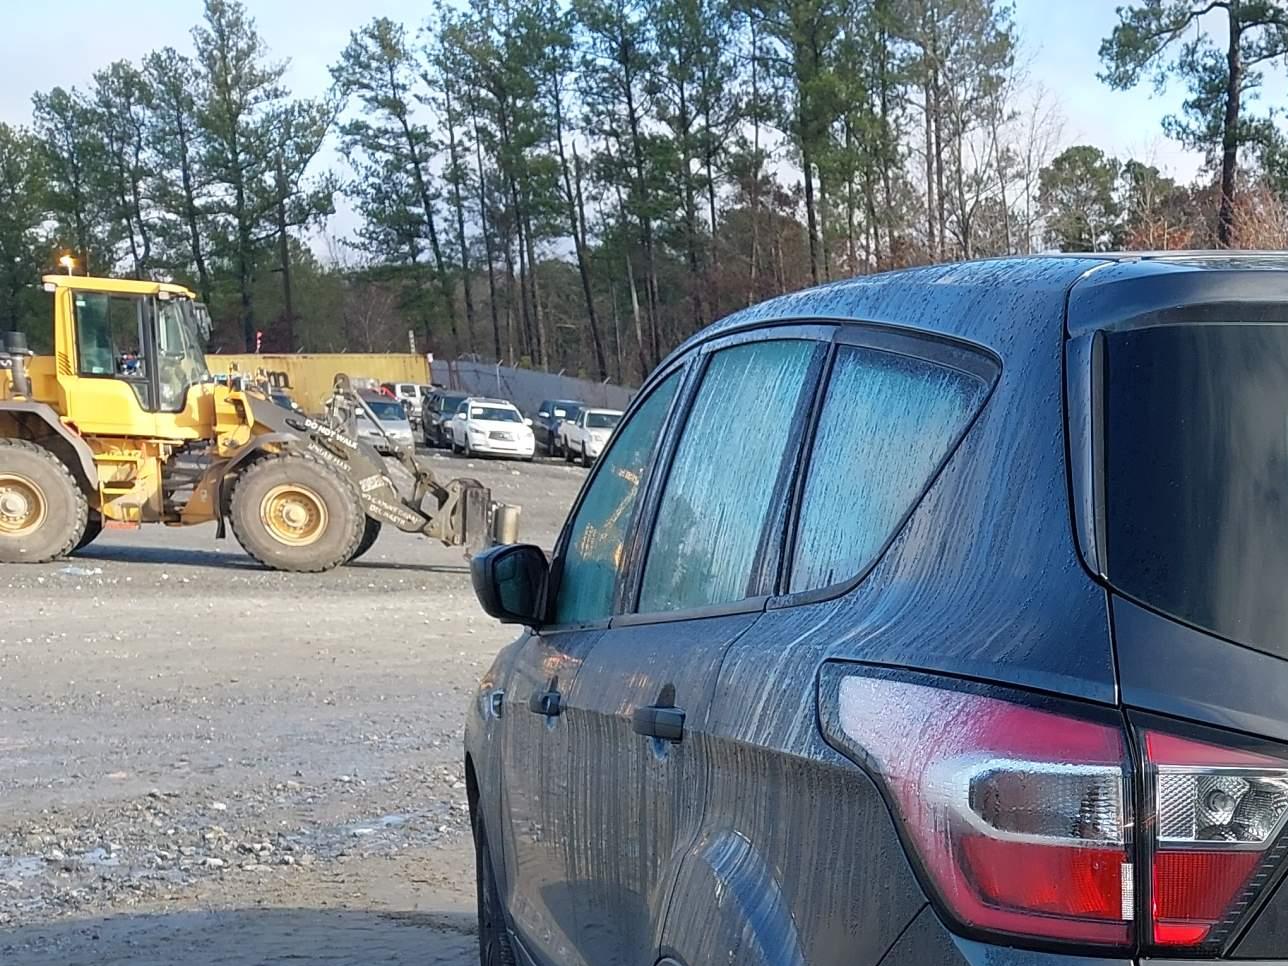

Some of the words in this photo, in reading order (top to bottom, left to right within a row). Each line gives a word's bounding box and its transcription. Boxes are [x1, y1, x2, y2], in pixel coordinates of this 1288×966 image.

[304, 419, 318, 430] DO
[319, 424, 336, 438] NOT
[335, 432, 359, 450] WALK
